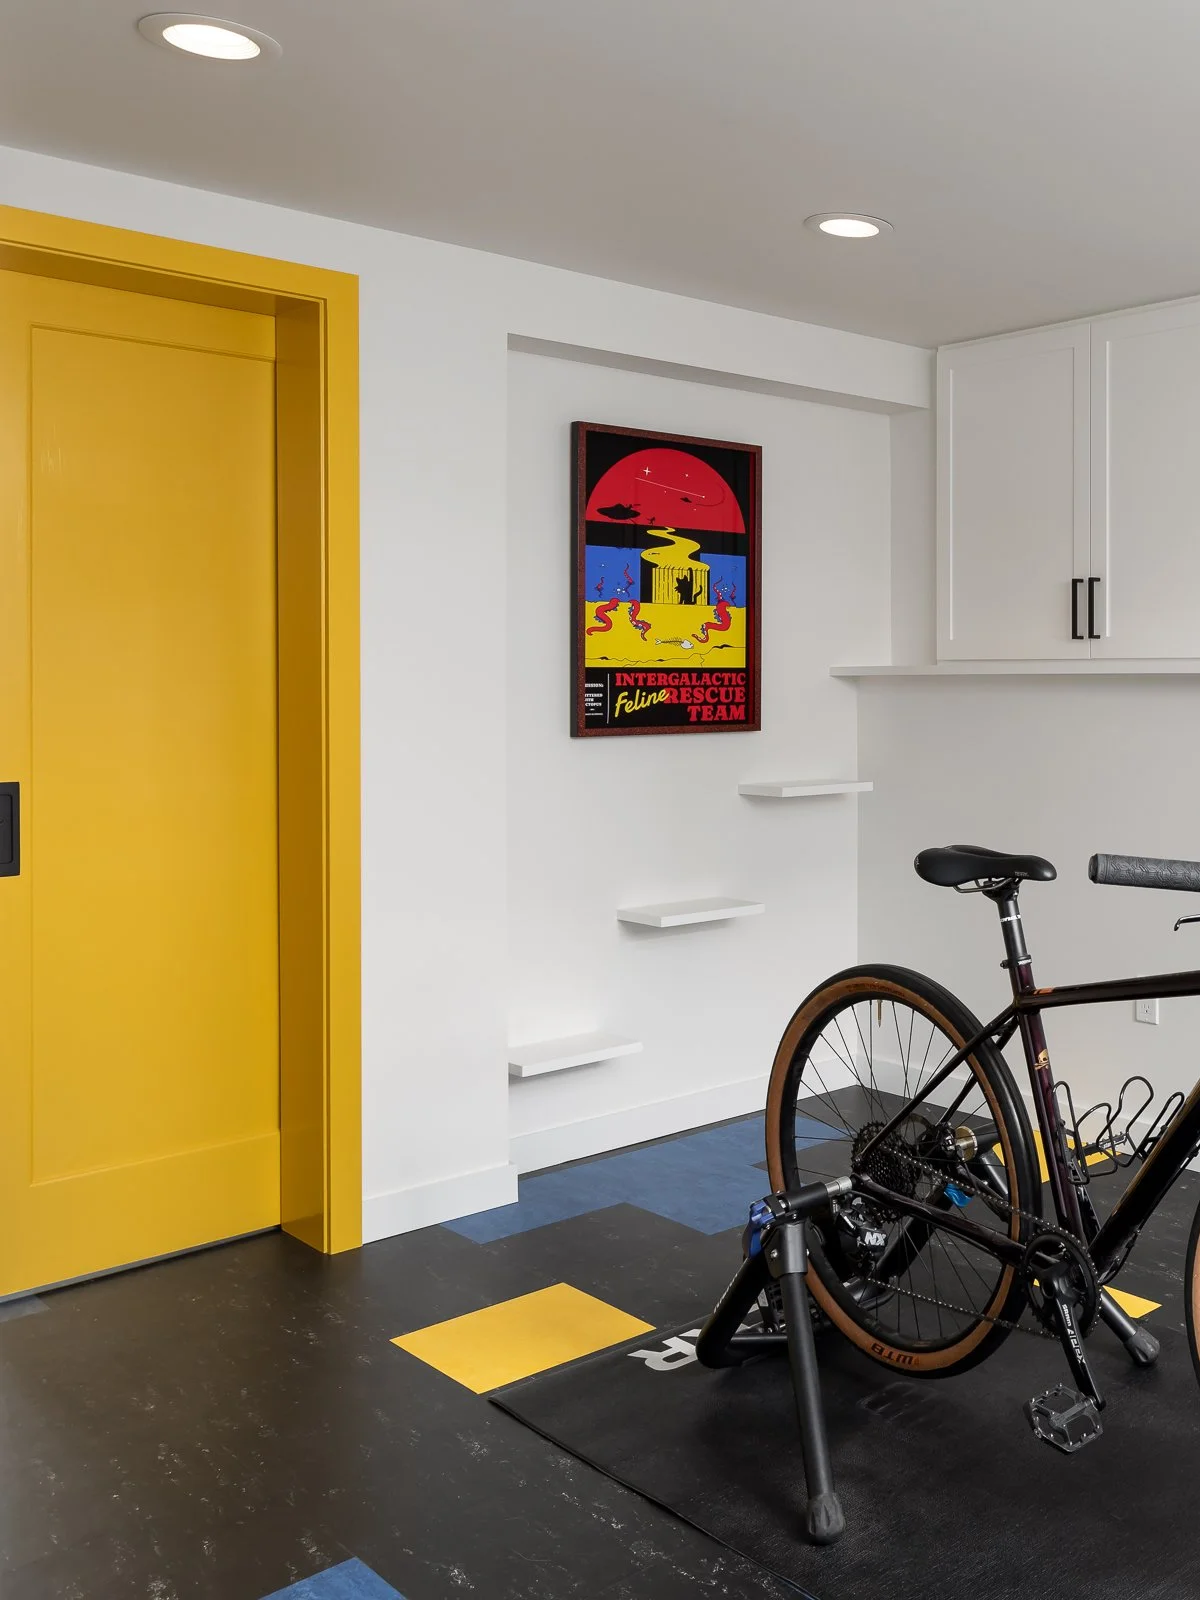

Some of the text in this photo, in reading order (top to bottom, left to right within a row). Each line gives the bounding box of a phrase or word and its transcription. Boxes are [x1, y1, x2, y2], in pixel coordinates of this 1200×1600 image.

[615, 672, 746, 686] INTERGALACTIC
[614, 688, 670, 718] Feline
[663, 687, 745, 704] RESCUE
[687, 705, 745, 722] TEAM
[864, 1231, 887, 1246] NX
[870, 1342, 913, 1365] WTB
